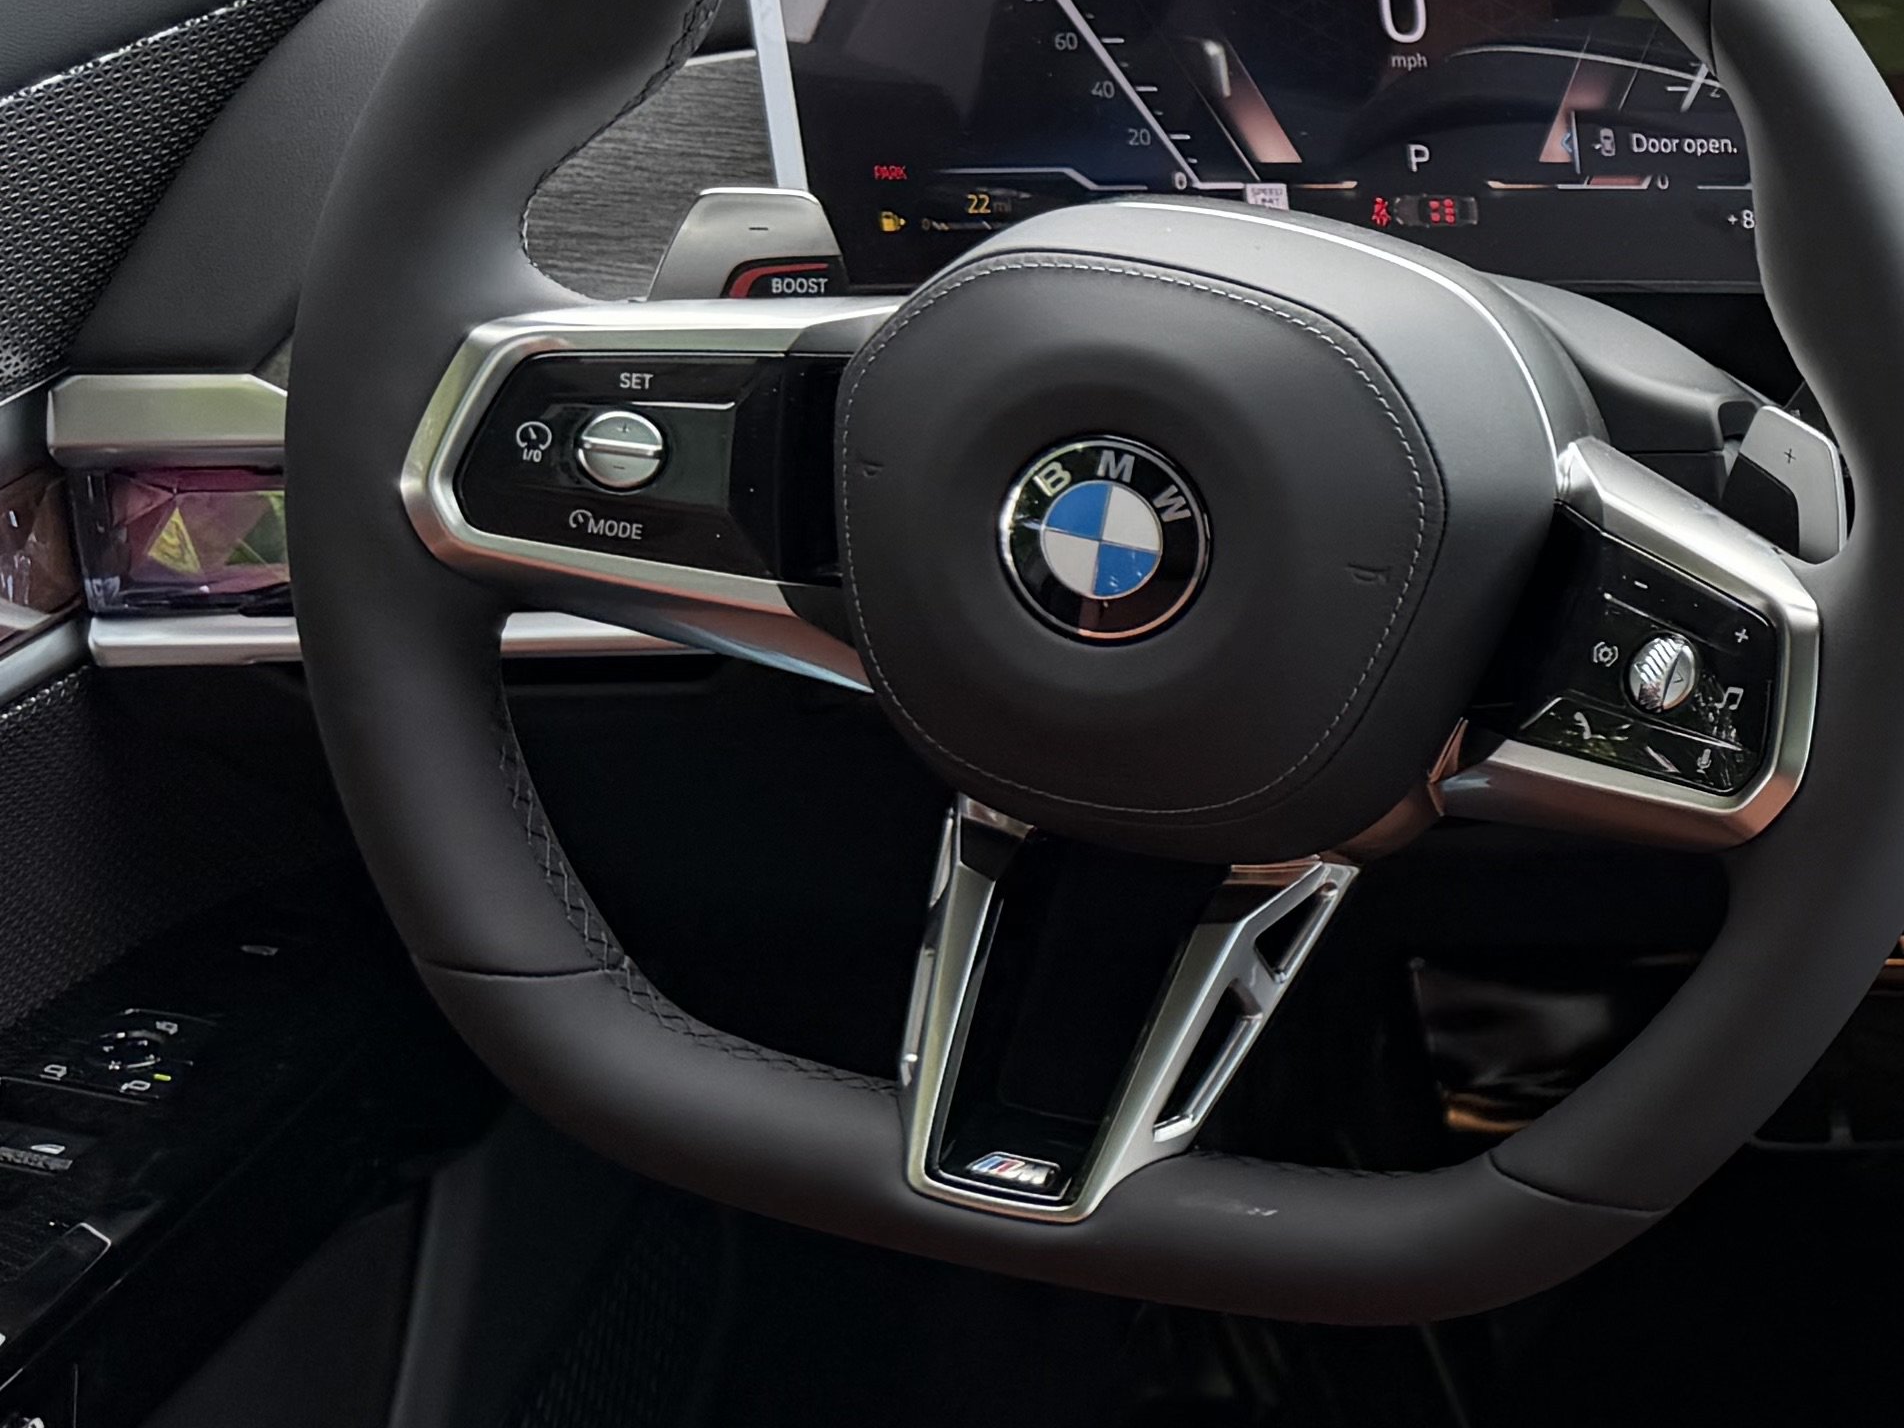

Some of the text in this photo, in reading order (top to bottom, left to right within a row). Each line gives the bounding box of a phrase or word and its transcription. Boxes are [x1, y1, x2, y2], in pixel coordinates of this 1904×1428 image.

[1053, 33, 1079, 51] 60
[1391, 52, 1428, 72] mph
[1090, 80, 1116, 99] 40
[1127, 128, 1152, 146] 20
[1631, 131, 1739, 157] Door open.
[1407, 143, 1431, 174] P
[873, 164, 909, 182] PARK
[1172, 172, 1188, 190] 0
[966, 194, 991, 214] 22
[771, 276, 829, 294] BOOST
[619, 372, 655, 390] SET
[1033, 449, 1192, 524] BMW
[587, 518, 644, 540] MODE
